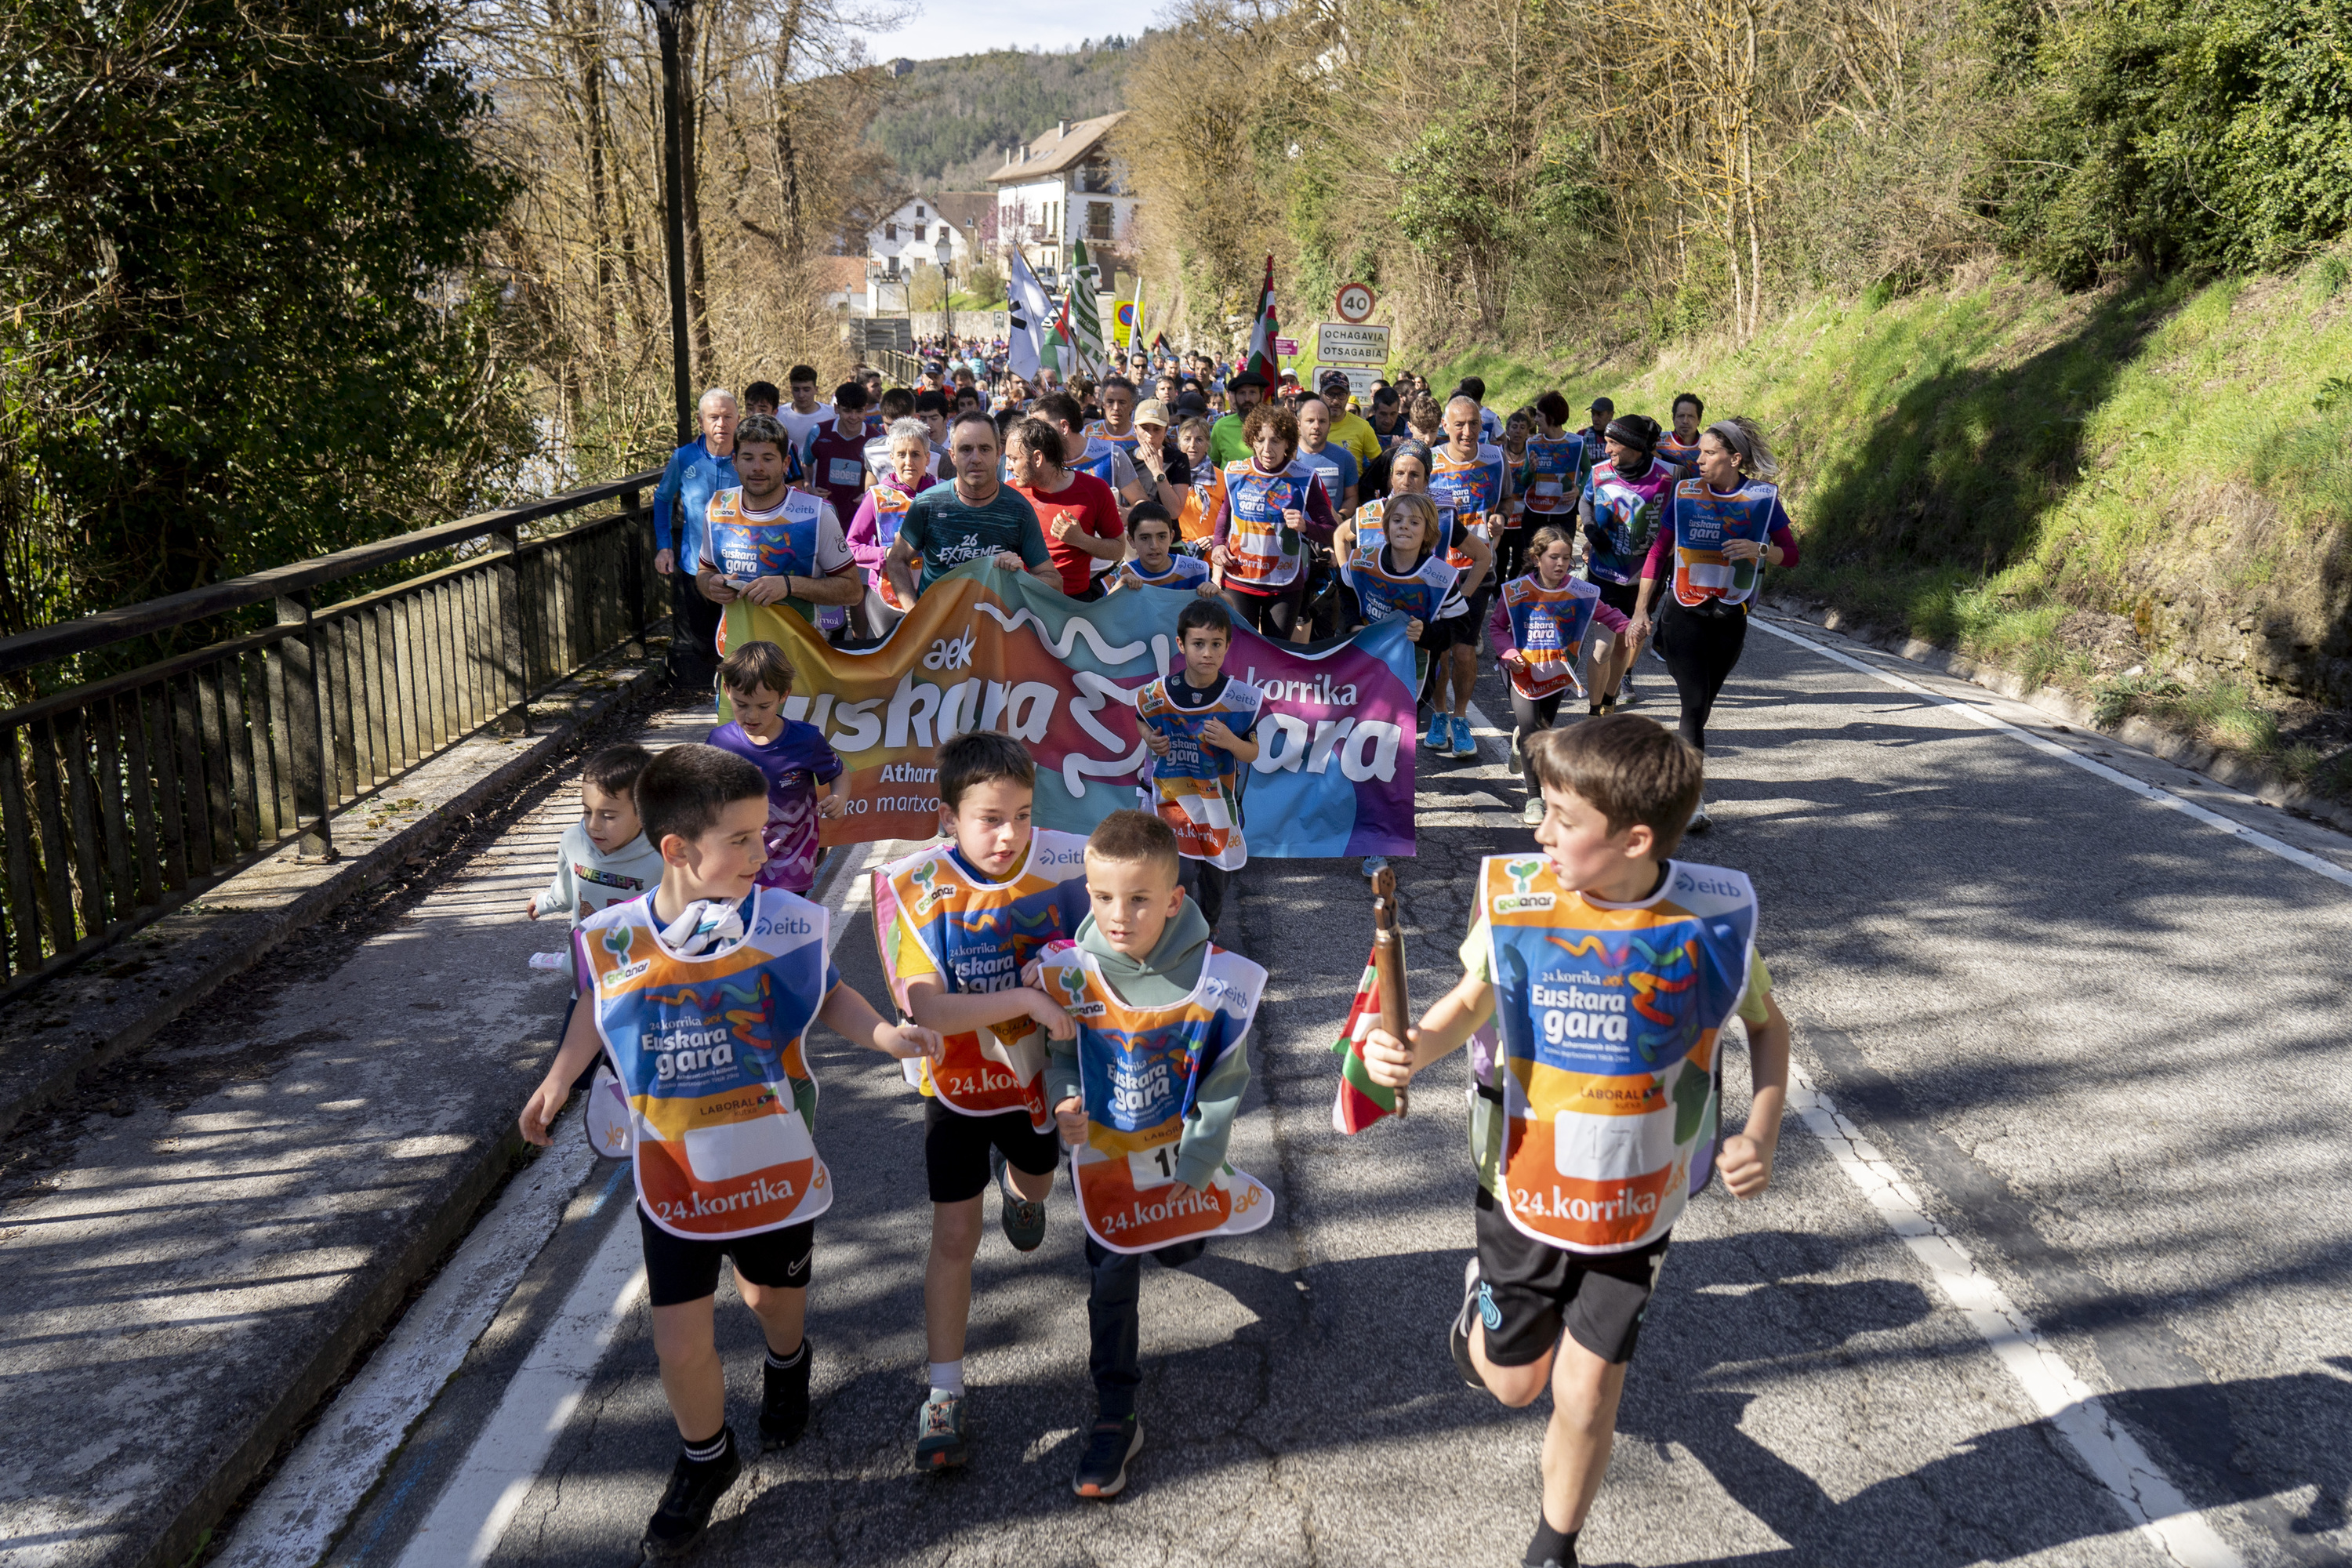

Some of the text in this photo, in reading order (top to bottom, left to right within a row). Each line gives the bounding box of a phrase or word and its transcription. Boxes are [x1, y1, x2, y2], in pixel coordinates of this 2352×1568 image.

[1344, 296, 1367, 310] 40
[1325, 330, 1385, 342] OCHAGAVIA
[1323, 347, 1382, 358] OTSAGABIA
[830, 469, 860, 481] SBOBET
[796, 505, 815, 514] eitb
[1240, 501, 1265, 513] gara
[1689, 519, 1721, 529] Euskara
[961, 533, 978, 546] 26
[1689, 528, 1720, 540] gara
[721, 549, 757, 561] Euskara
[936, 544, 1005, 564] EXTREME
[725, 560, 757, 574] gara
[1188, 561, 1204, 570] eitb
[1431, 571, 1448, 584] eitb
[1578, 586, 1595, 594] eitb
[1523, 621, 1554, 630] Euskara
[1527, 630, 1555, 642] gara
[923, 624, 977, 670] aek
[1247, 666, 1359, 706] korrika
[1235, 694, 1256, 706] eitb
[782, 667, 1059, 752] uskara
[1168, 739, 1198, 751] uskara
[1251, 713, 1402, 782] ara
[1166, 750, 1199, 767] gara
[880, 762, 938, 783] Atharr
[877, 794, 941, 813] martxo
[574, 862, 644, 891] MINECRAFT
[1698, 879, 1741, 898] eitb
[775, 916, 811, 936] eitb
[949, 942, 996, 957] 24.korrika
[1541, 968, 1601, 986] 24.korrika
[1225, 985, 1248, 1010] eitb
[1532, 984, 1626, 1013] Euskara
[649, 1016, 702, 1030] 24.korrika
[1543, 1009, 1628, 1045] gara
[641, 1028, 728, 1051] Euskara
[655, 1044, 734, 1080] gara
[1106, 1063, 1167, 1090] Euskara
[1113, 1077, 1170, 1112] gara
[1581, 1086, 1641, 1101] LABORAL
[700, 1098, 755, 1116] LABORAL
[1144, 1123, 1184, 1142] LABORA
[658, 1178, 794, 1222] 24.korrika
[1515, 1184, 1657, 1223] 24.korrika
[1102, 1191, 1222, 1235] 24.korrika
